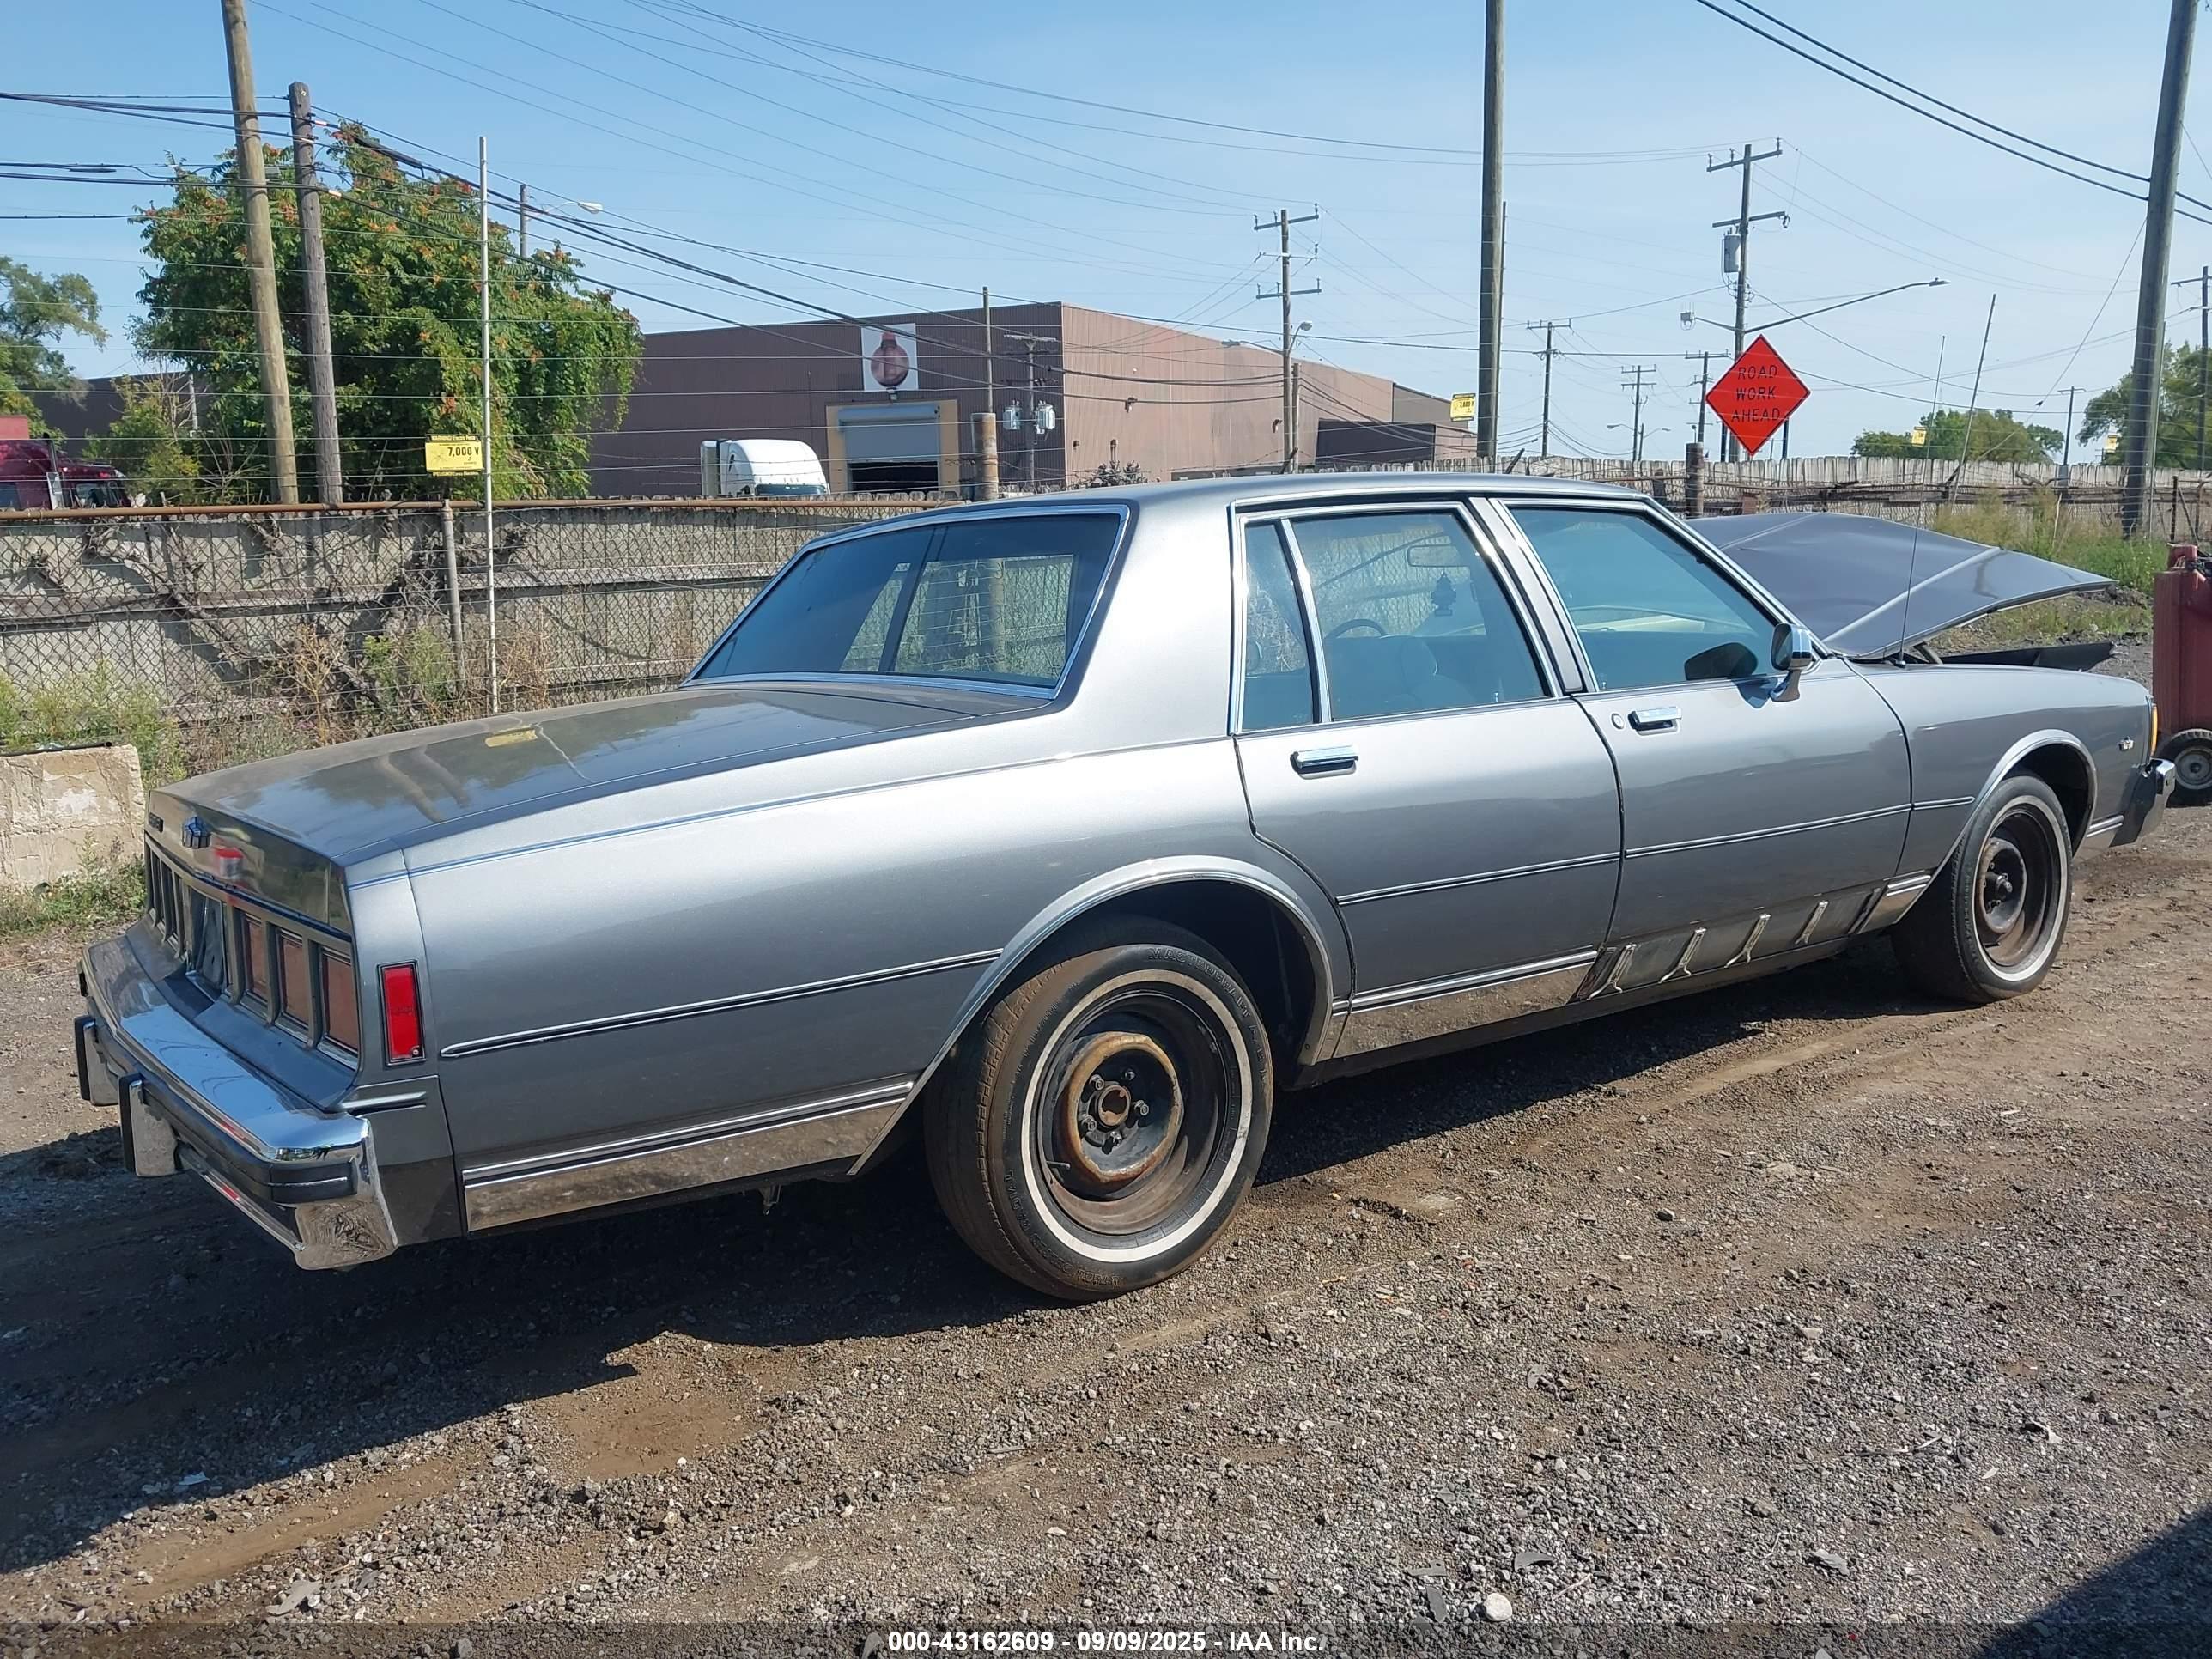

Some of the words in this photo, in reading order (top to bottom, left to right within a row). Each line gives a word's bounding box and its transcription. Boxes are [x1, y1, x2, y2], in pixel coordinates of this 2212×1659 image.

[1738, 365, 1777, 379] ROAD
[1735, 386, 1776, 401] WORK
[1731, 408, 1780, 422] AHEAD
[447, 447, 472, 457] 7,000
[474, 447, 480, 455] V
